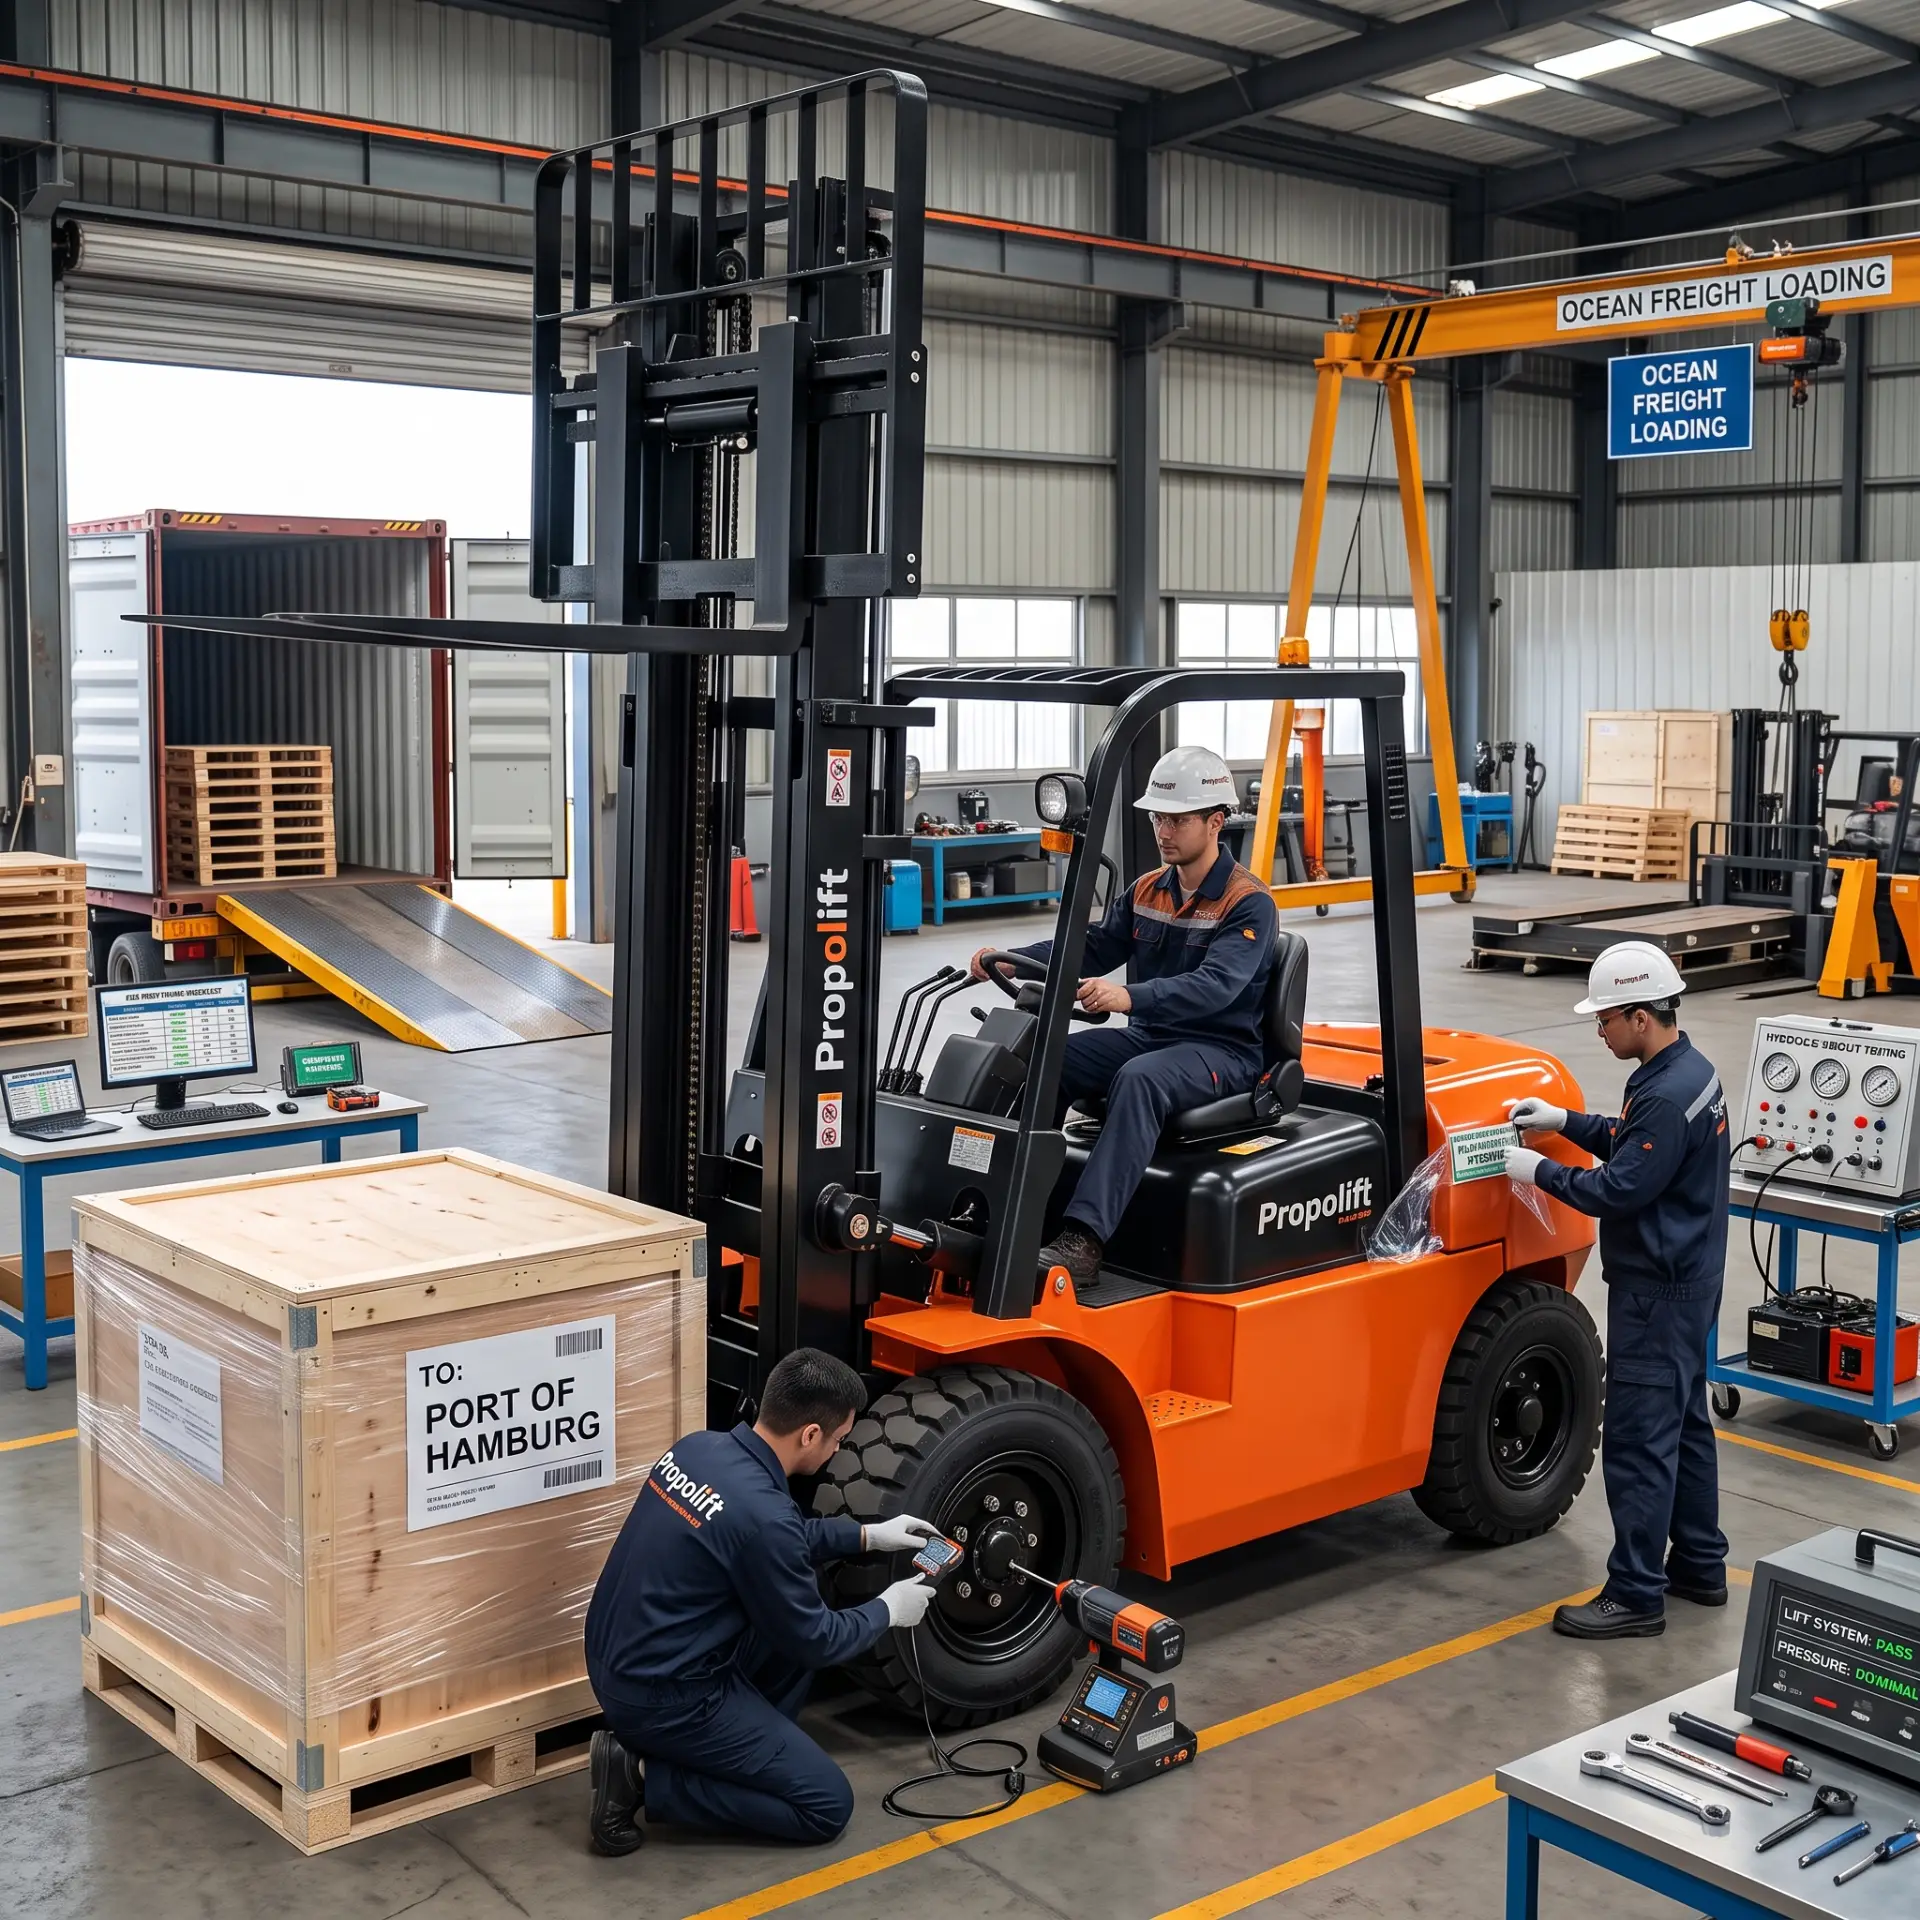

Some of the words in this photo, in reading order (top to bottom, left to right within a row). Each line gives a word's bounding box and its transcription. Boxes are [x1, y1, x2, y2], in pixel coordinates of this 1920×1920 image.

[1562, 292, 1642, 323] OCEAN
[1651, 278, 1757, 313] FREIGHT
[1765, 263, 1886, 301] LOADING
[1642, 359, 1718, 386] OCEAN
[1633, 387, 1727, 416] FREIGHT
[1630, 416, 1728, 444] LOADING
[815, 868, 854, 1071] Propolift
[1258, 1177, 1372, 1235] Propolift
[419, 1362, 462, 1387] TO:
[426, 1387, 520, 1434] PORT
[531, 1377, 575, 1411] OF
[427, 1411, 600, 1474] HAMBURG
[655, 1451, 724, 1521] Propolift
[1777, 1640, 1851, 1677] PRESSURE:
[1813, 1617, 1872, 1647] SYSTEM:
[1876, 1638, 1913, 1661] PASS
